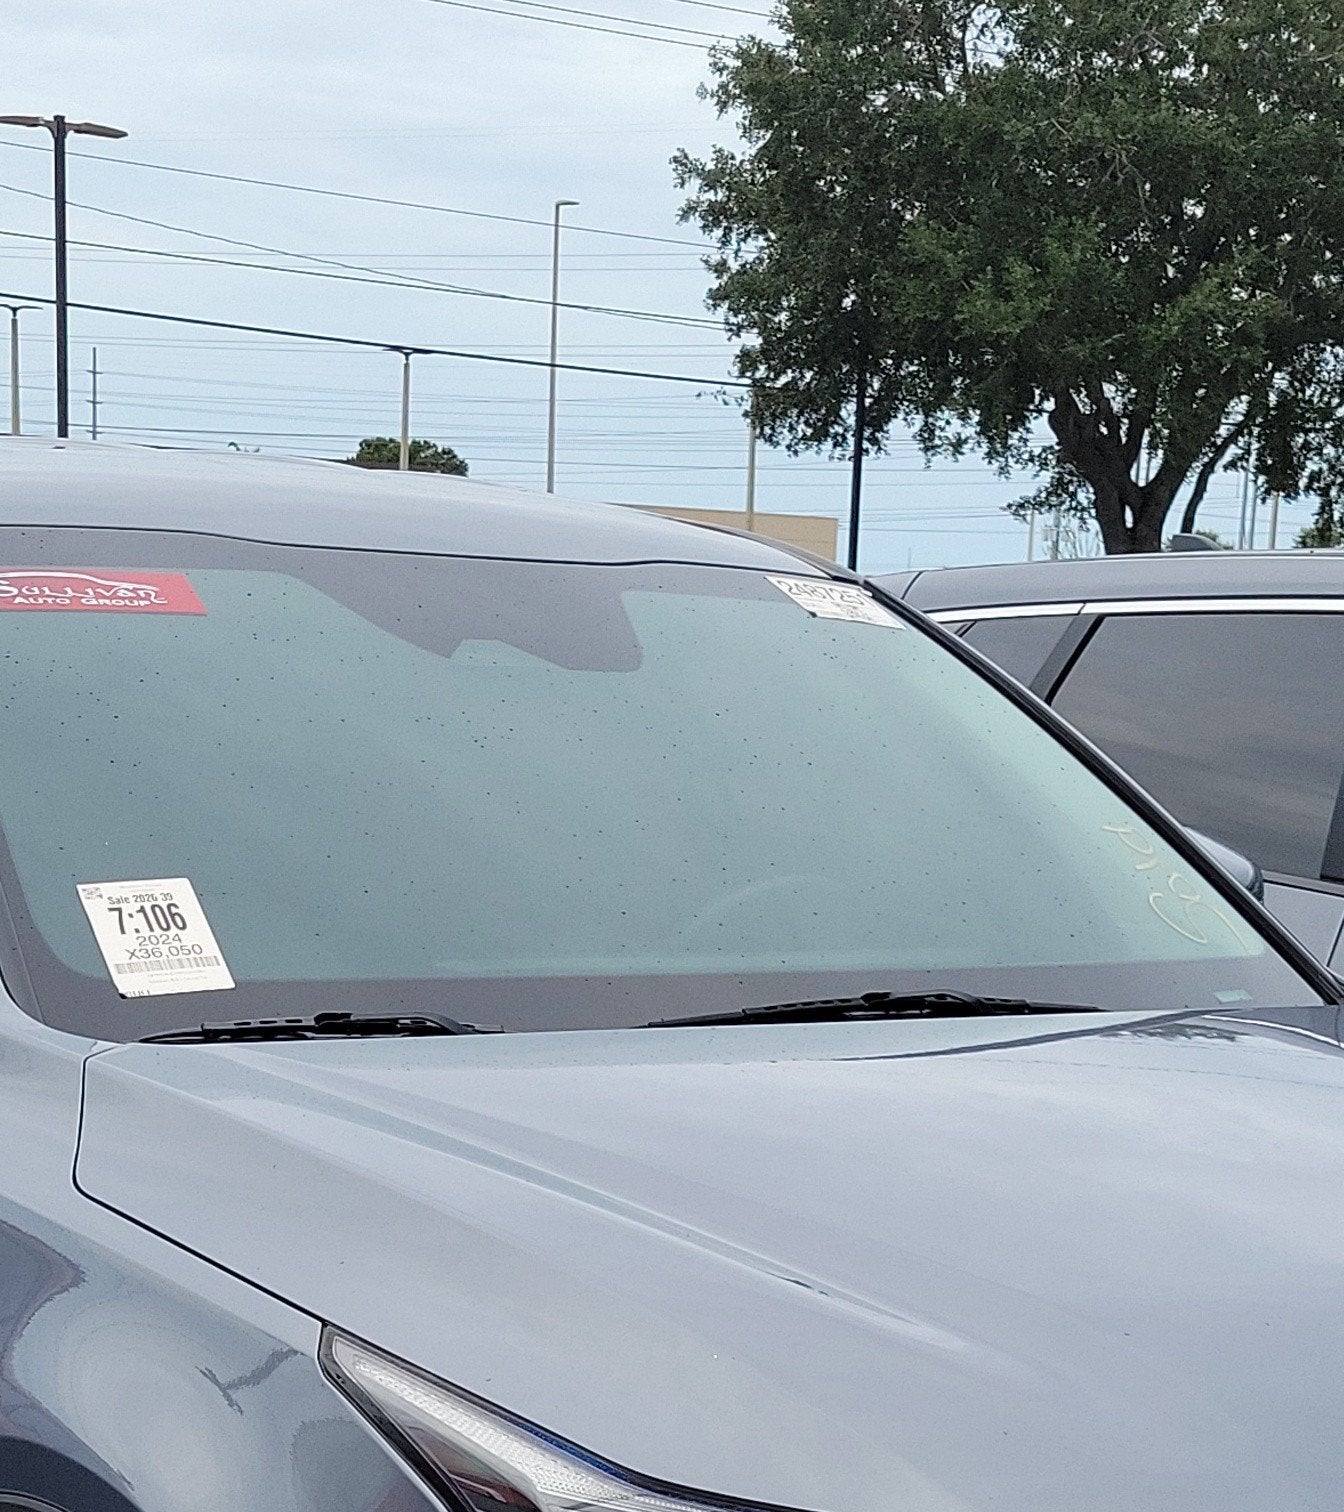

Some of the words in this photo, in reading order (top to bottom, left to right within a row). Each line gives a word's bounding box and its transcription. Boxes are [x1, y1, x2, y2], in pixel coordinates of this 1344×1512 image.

[12, 596, 71, 605] AUTO
[80, 597, 151, 607] GROUP
[107, 895, 131, 905] Sale
[107, 903, 187, 935] 7:106
[136, 933, 183, 947] 2024
[125, 943, 203, 960] X36,050
